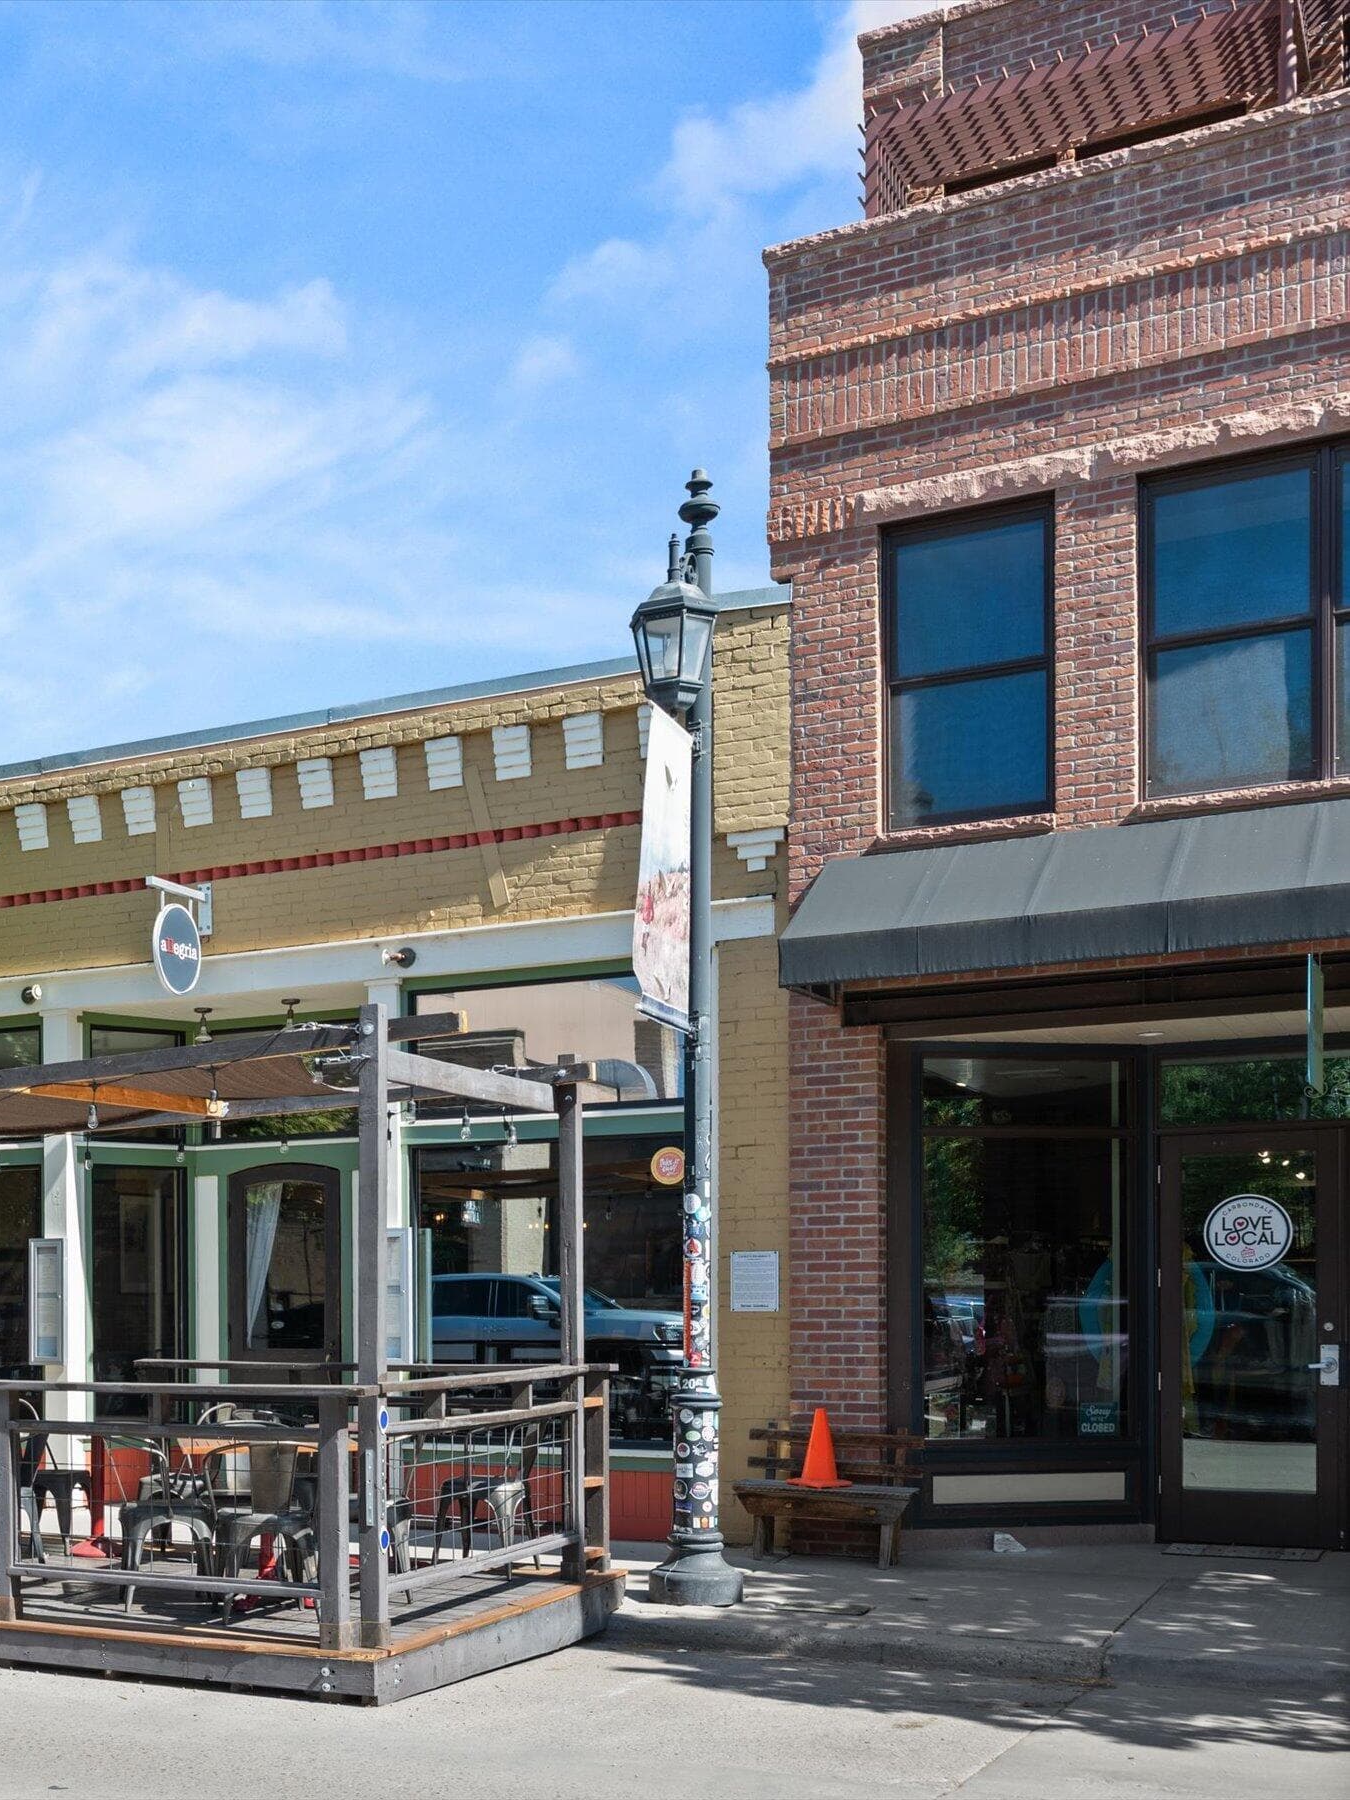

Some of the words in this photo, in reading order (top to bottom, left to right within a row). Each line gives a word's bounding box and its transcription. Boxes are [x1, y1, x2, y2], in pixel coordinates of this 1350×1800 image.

[1222, 1202, 1274, 1216] CARBONDALE
[1222, 1216, 1272, 1231] LOVE
[1215, 1231, 1282, 1246] LOCAL
[1226, 1252, 1270, 1264] COLORADO
[1081, 1423, 1115, 1432] CLOSED
